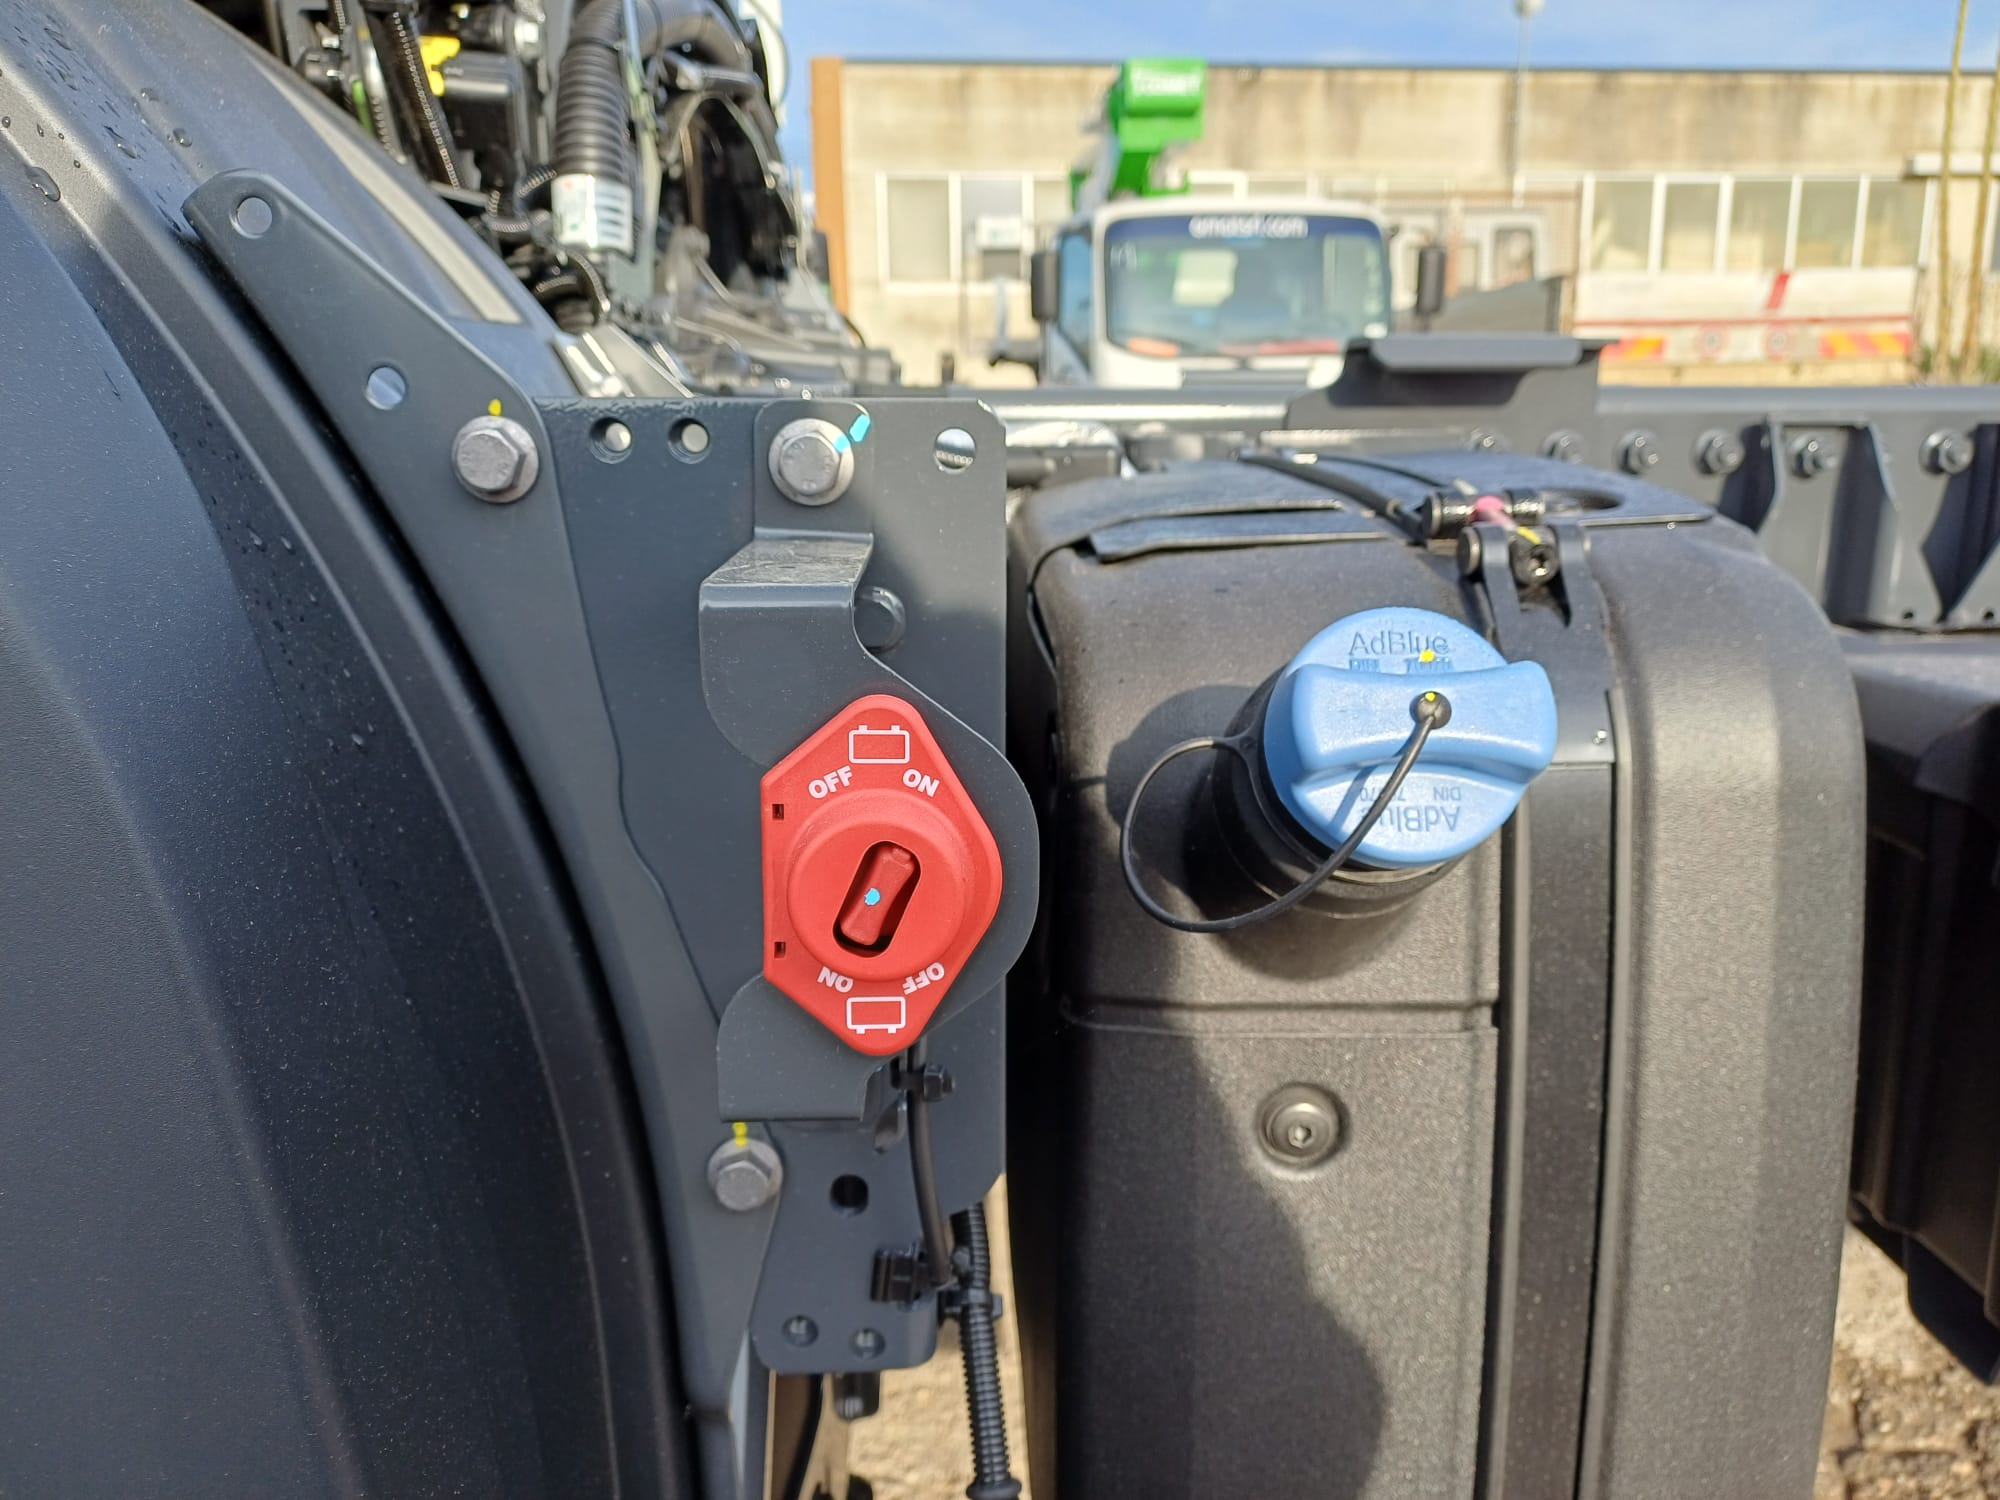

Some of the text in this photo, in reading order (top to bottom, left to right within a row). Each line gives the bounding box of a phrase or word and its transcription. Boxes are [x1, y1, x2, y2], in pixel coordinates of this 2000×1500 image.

[1349, 630, 1449, 655] AdBlue
[808, 766, 852, 799] OFF
[903, 768, 939, 797] ON
[1433, 786, 1461, 801] DIN
[1360, 806, 1461, 832] AdBlu
[816, 966, 854, 993] ON
[903, 962, 945, 995] OFF
